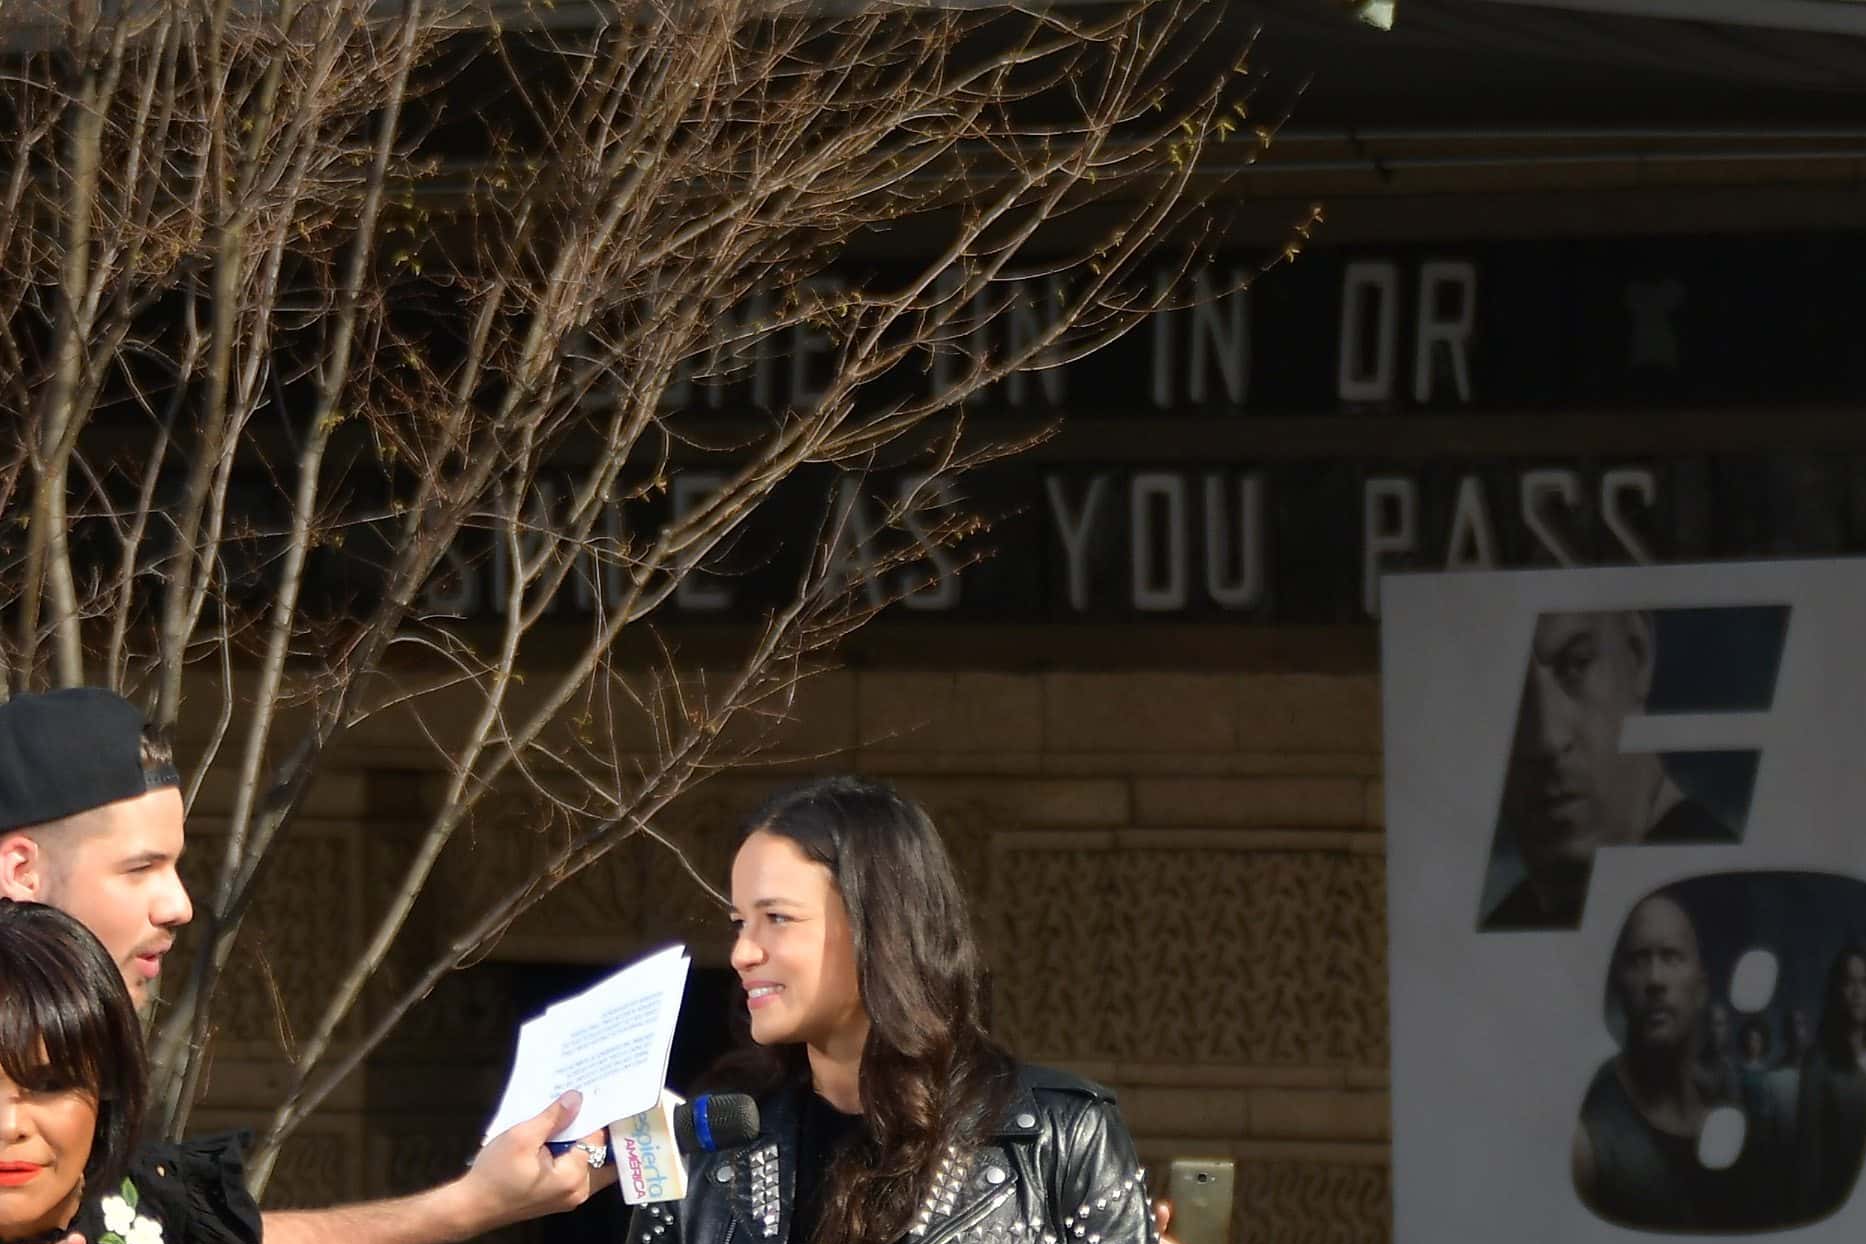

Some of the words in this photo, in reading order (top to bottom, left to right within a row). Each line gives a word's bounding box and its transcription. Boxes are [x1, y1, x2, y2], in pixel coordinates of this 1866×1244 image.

[1147, 269, 1255, 408] IN
[1337, 257, 1478, 405] OR
[1043, 470, 1265, 613] YOU
[1363, 467, 1658, 619] PASS
[632, 1112, 669, 1198] espierta
